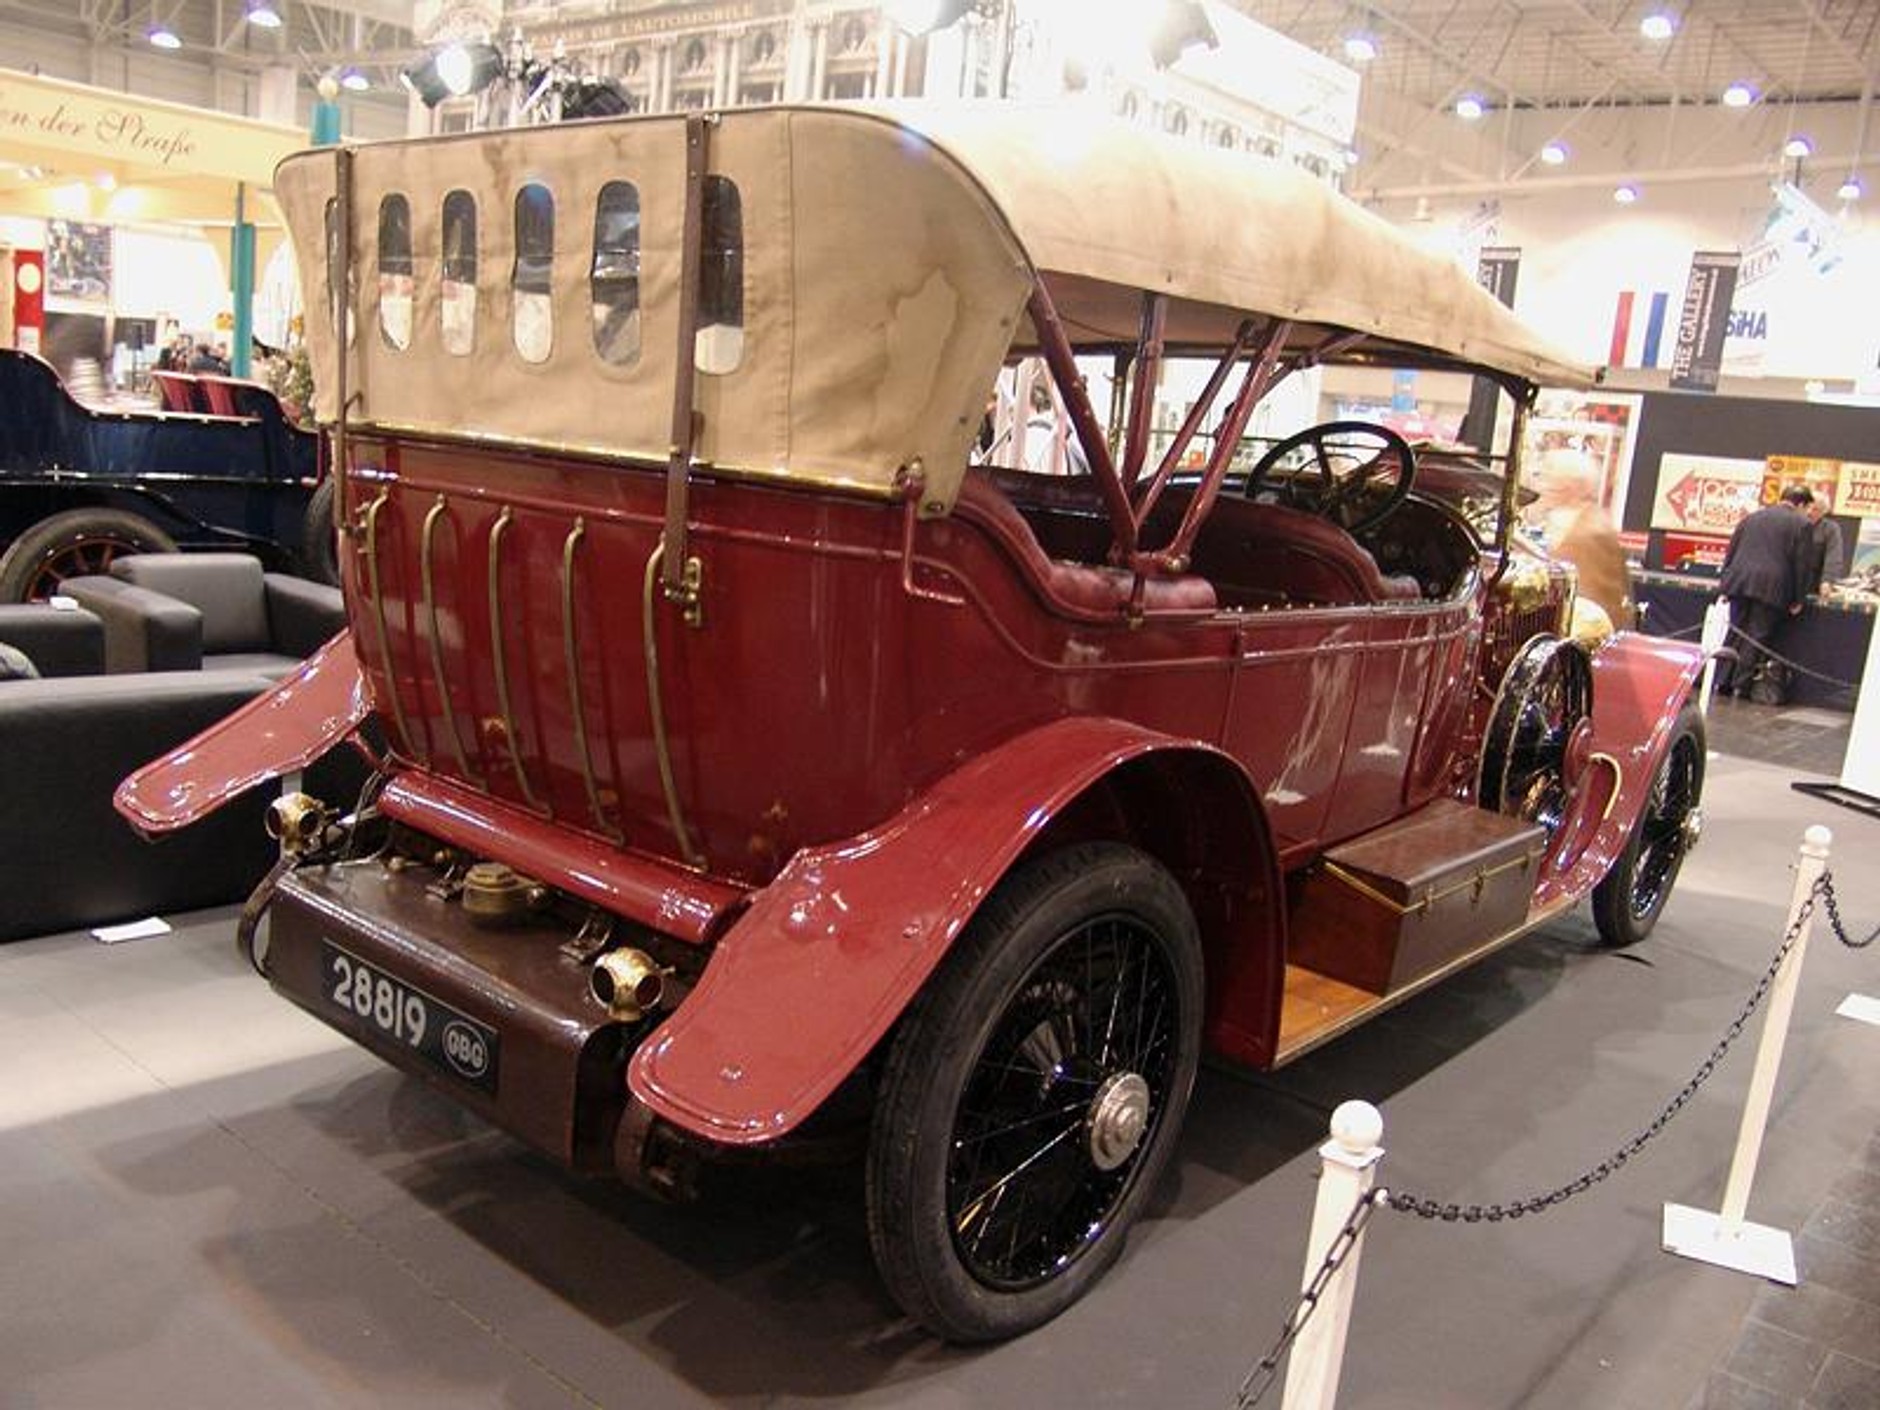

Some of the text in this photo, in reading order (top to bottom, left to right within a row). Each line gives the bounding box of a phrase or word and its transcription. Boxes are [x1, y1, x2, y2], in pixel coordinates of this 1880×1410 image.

[39, 104, 86, 137] der
[95, 108, 198, 165] Straße
[1672, 267, 1707, 379] THE GALLERY
[333, 955, 427, 1048] 28819
